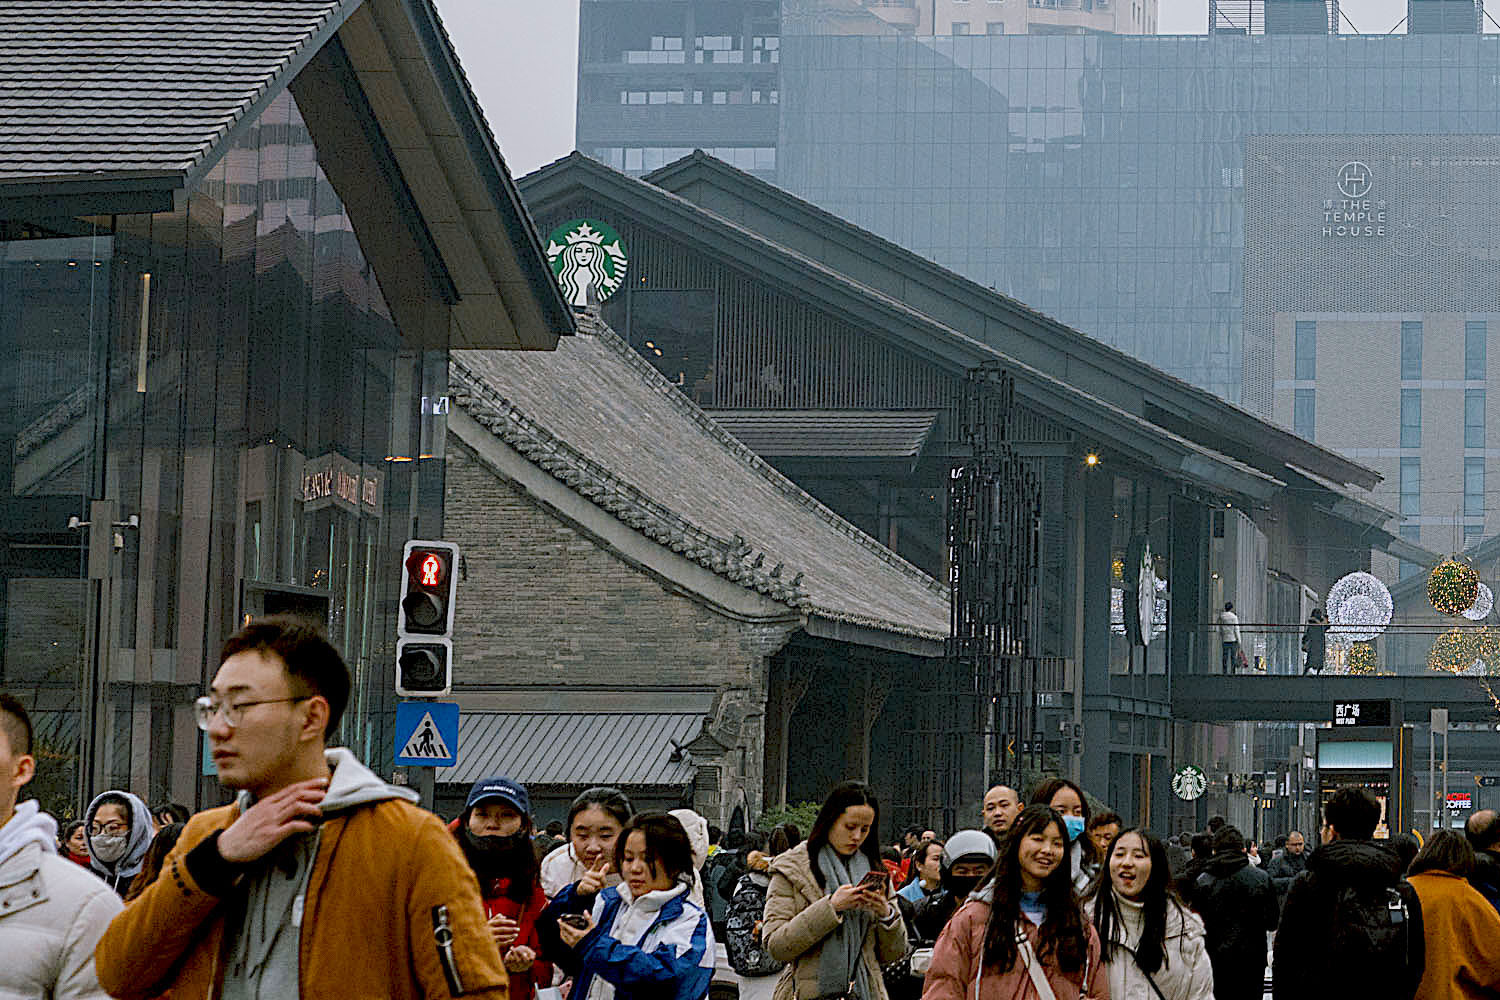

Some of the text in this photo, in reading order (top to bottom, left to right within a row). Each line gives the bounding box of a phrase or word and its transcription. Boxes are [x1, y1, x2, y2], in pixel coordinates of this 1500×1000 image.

[1341, 199, 1370, 210] THE
[1323, 212, 1386, 222] TEMPLE
[1322, 226, 1385, 237] HOUSE
[1335, 703, 1360, 717] 西广场
[1446, 792, 1471, 800] ACIFIC
